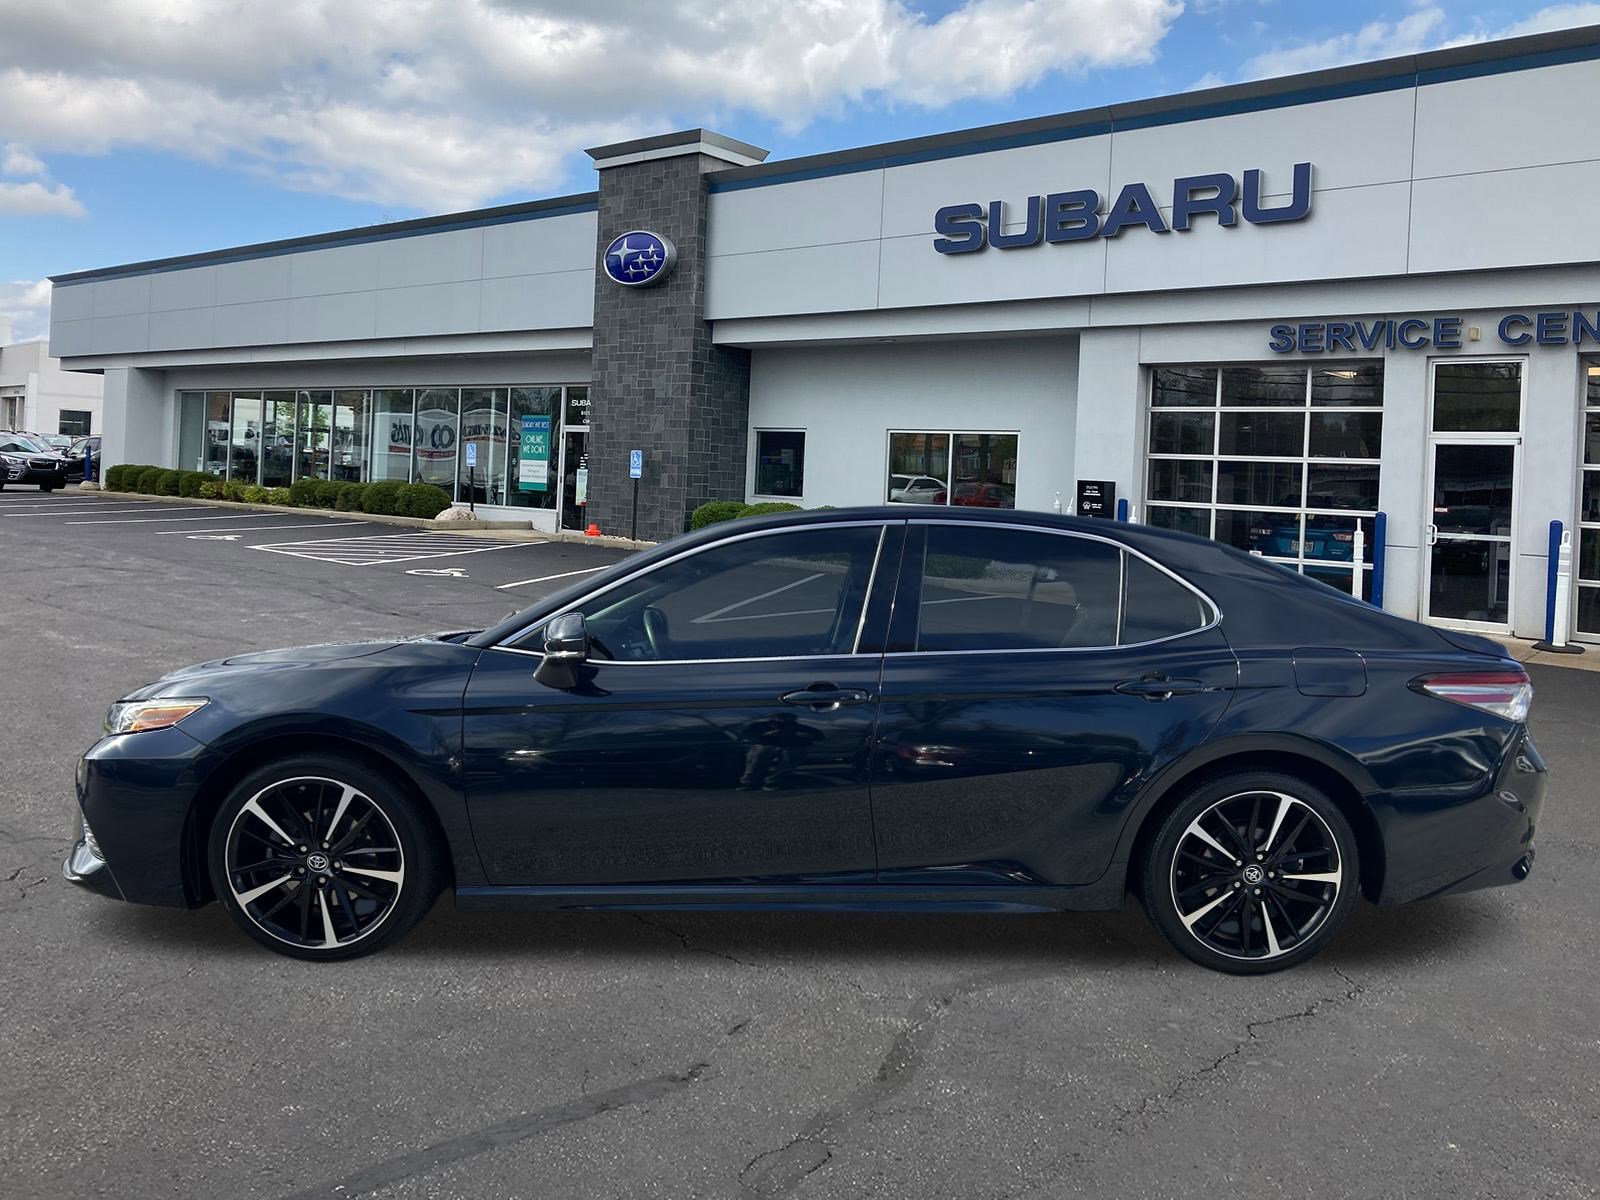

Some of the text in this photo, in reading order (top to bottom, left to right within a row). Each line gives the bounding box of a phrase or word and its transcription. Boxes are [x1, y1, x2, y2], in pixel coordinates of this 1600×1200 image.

[933, 162, 1314, 255] SUBARU
[1269, 311, 1600, 353] SERVICE CEN
